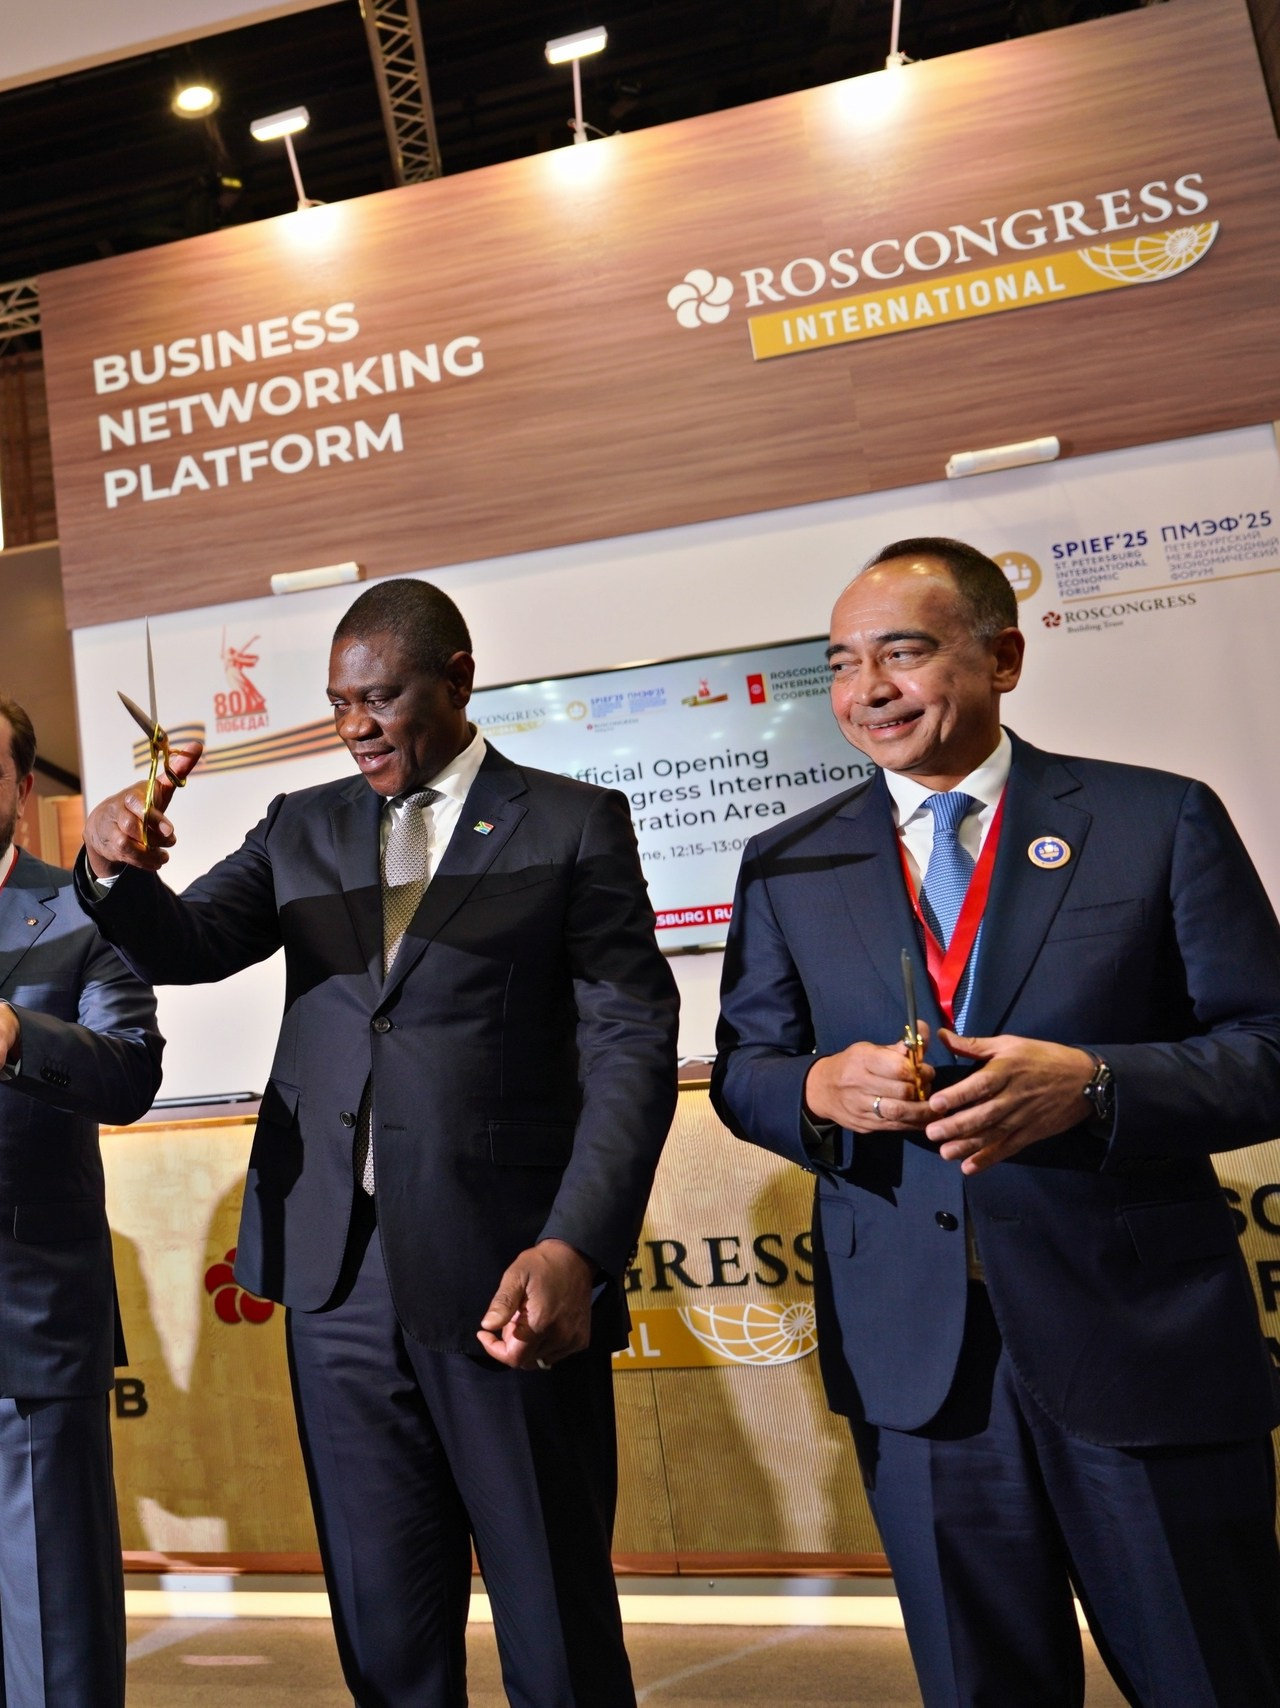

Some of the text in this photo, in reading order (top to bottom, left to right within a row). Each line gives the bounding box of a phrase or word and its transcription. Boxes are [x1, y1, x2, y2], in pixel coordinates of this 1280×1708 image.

[741, 172, 1210, 307] ROSCONGRESS
[783, 266, 1067, 345] INTERNATIONAL
[93, 302, 360, 395] BUSINESS
[98, 336, 484, 452] NETWORKING
[104, 412, 404, 508] PLATFORM
[1161, 510, 1272, 542] ПМЭФ'25
[1052, 530, 1148, 559] SPIEF'25
[1072, 550, 1142, 567] PETERSBURG
[1056, 559, 1148, 578] INTERNATIONAL
[1058, 572, 1120, 588] ECONOMIC
[1170, 567, 1214, 580] ФОРУМ
[1060, 585, 1100, 597] FORUM
[1065, 592, 1197, 623] ROSCONGRESS
[214, 690, 242, 718] 80
[216, 714, 270, 734] ПОБЕДА!
[560, 749, 769, 785] fficial Opening
[632, 800, 787, 832] ration Area
